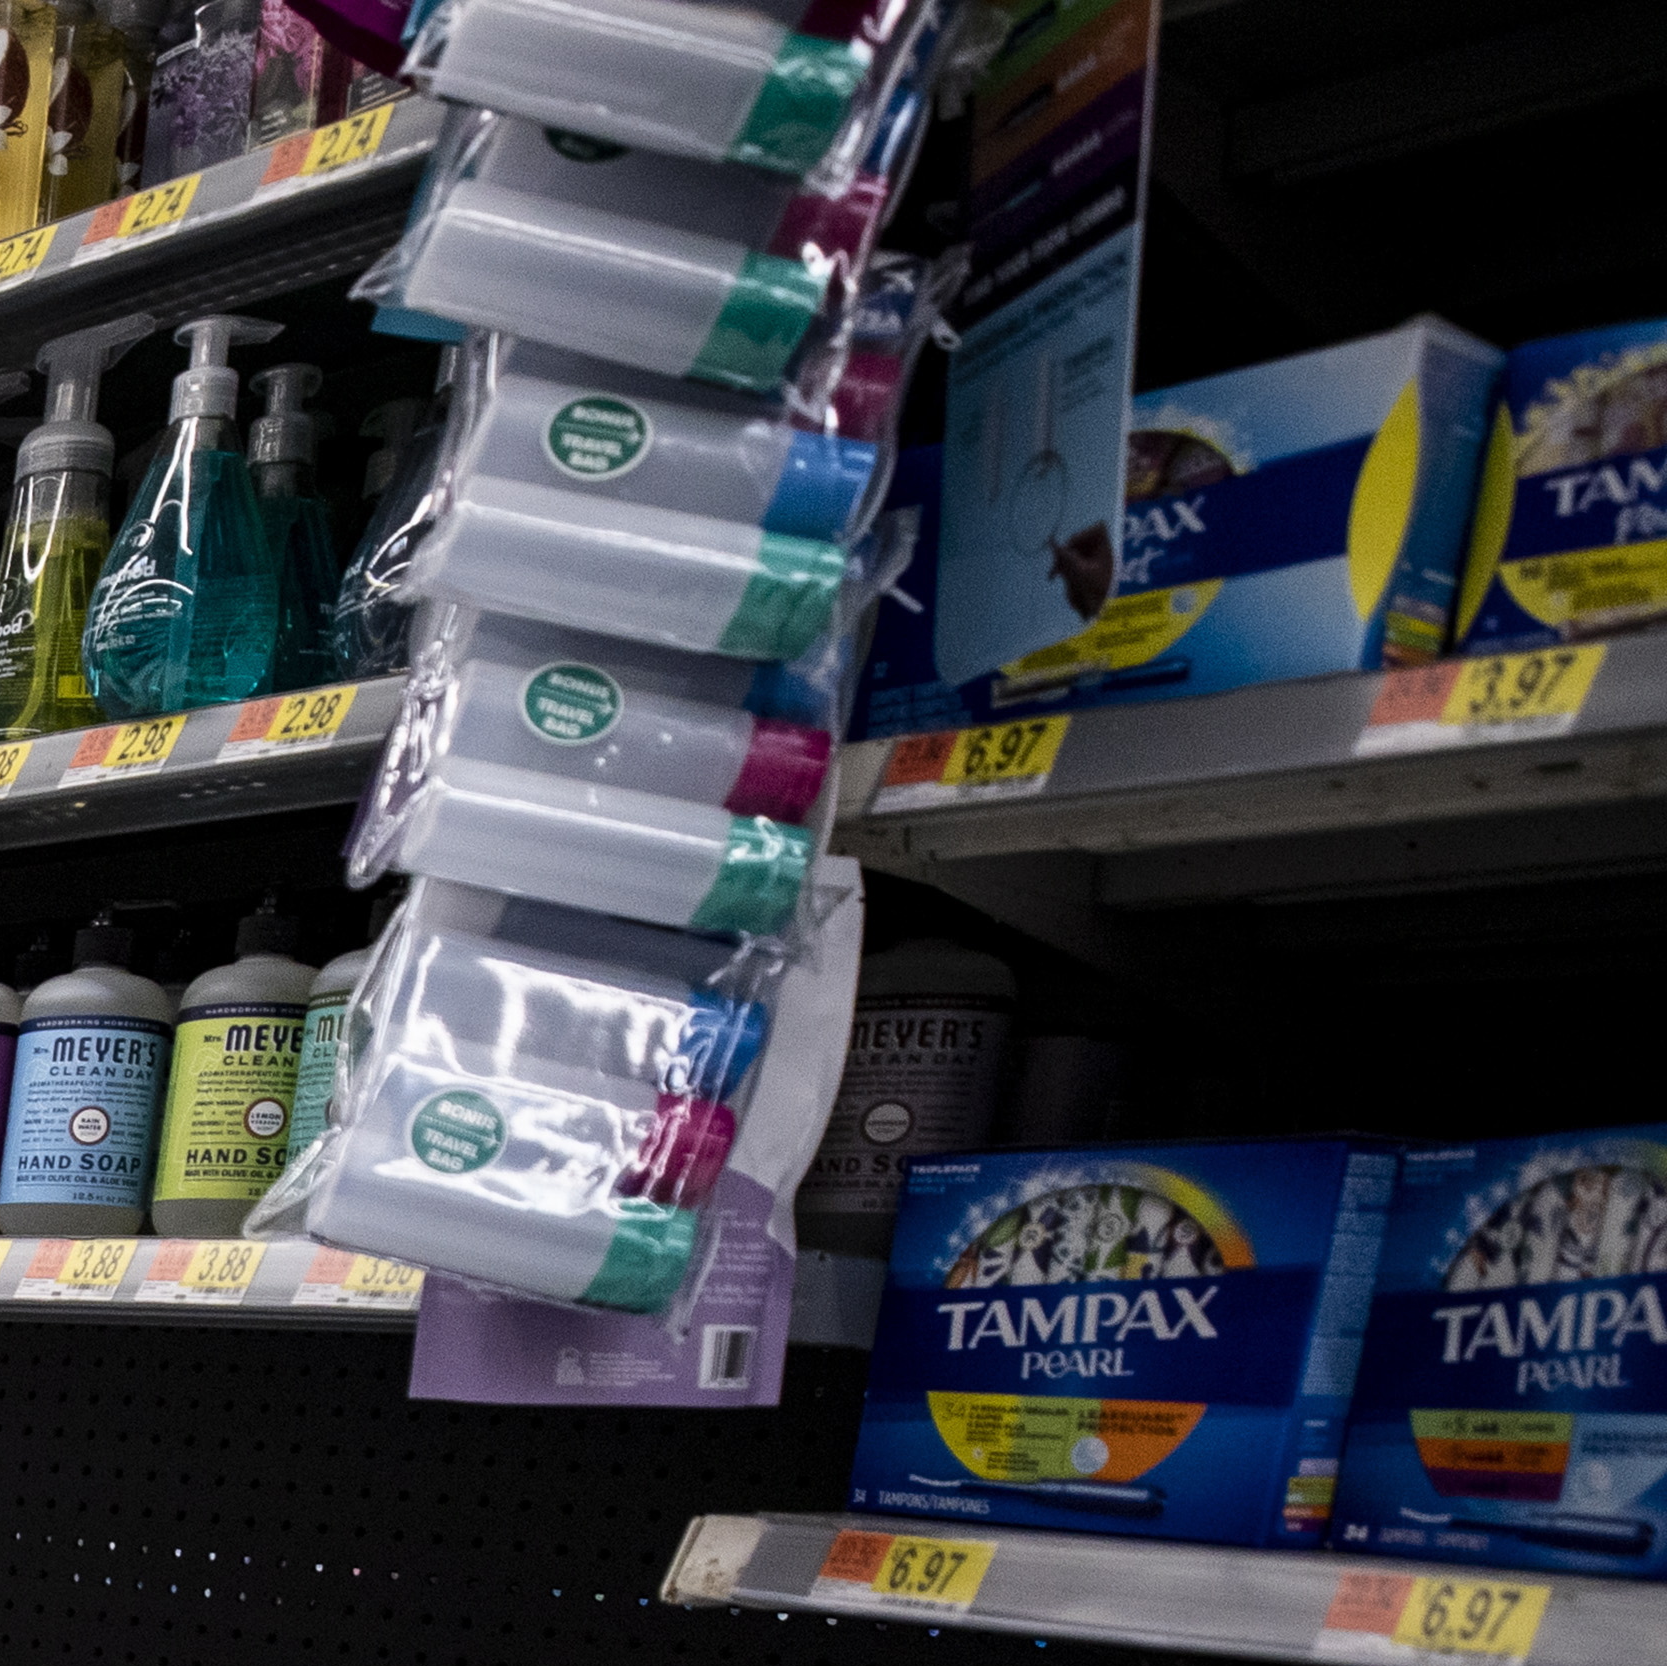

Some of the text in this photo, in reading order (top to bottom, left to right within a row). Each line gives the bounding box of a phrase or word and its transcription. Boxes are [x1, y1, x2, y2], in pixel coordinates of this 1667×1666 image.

[1543, 452, 1667, 520] TAM
[224, 1023, 305, 1053] MEYE
[52, 1035, 157, 1068] MEYER'S
[222, 1054, 296, 1068] CLEAN
[48, 1065, 154, 1081] CLEAN DAY
[77, 1123, 102, 1132] WATER
[80, 1117, 100, 1125] RAIN
[436, 1099, 498, 1131] BONUS
[424, 1126, 480, 1159] TRAVEL
[17, 1152, 143, 1175] HAND SOAP
[185, 1148, 248, 1165] HAND
[427, 1148, 466, 1171] BAG
[936, 1285, 1220, 1353] TAMPAX
[1431, 1284, 1667, 1365] TAMPA
